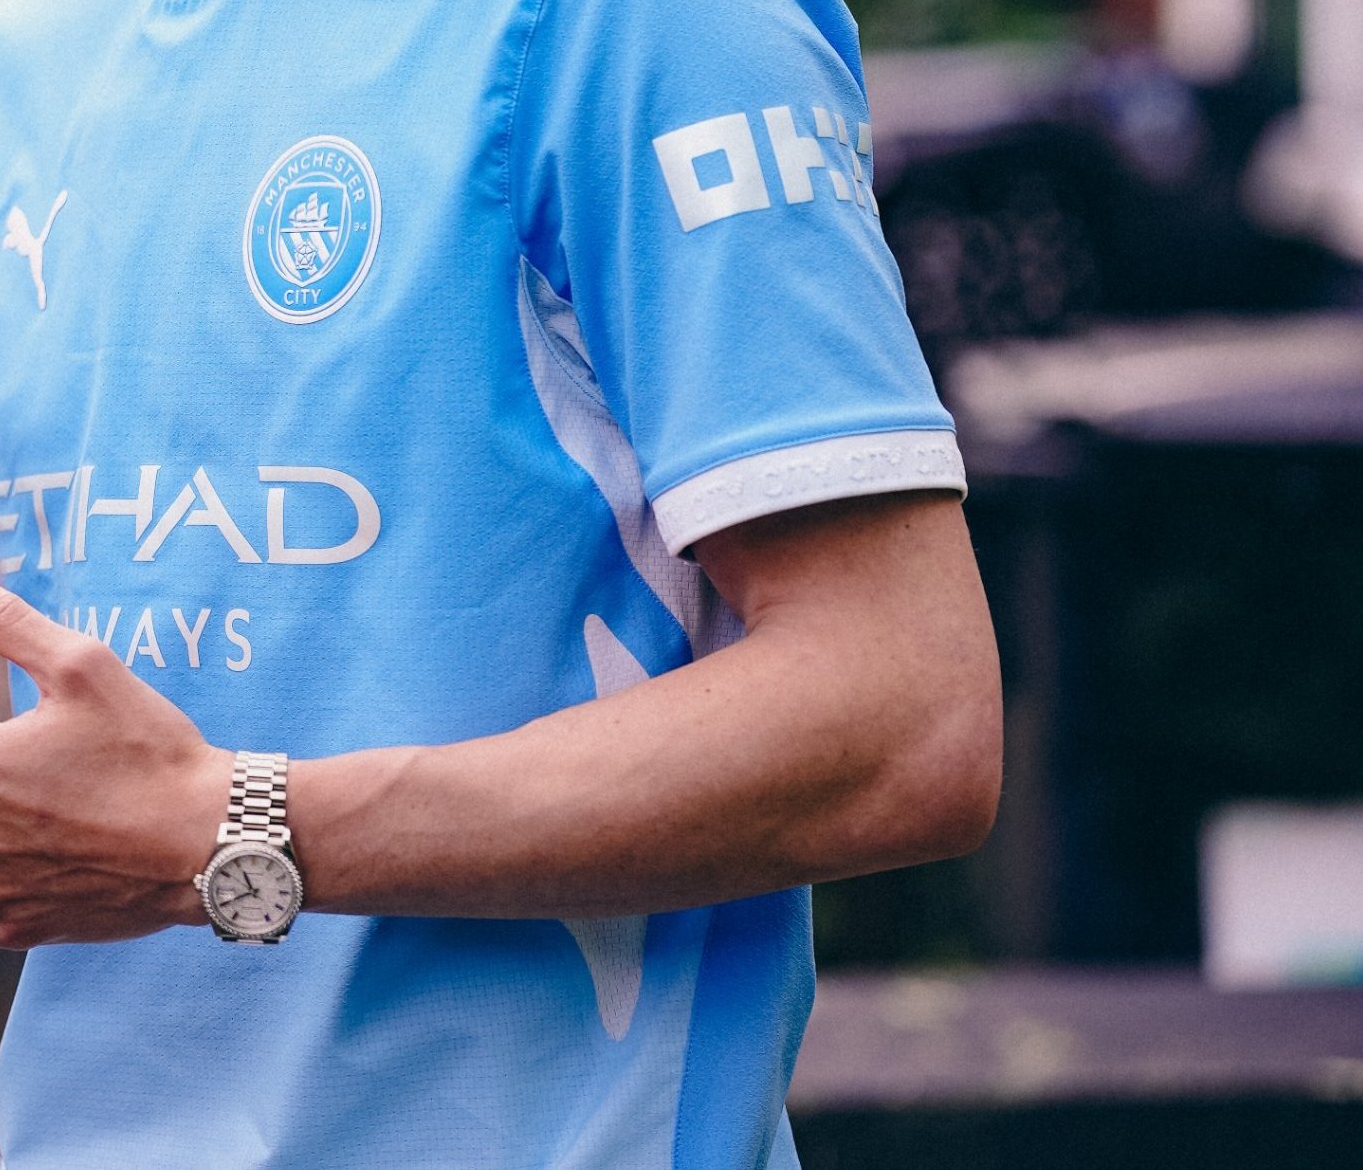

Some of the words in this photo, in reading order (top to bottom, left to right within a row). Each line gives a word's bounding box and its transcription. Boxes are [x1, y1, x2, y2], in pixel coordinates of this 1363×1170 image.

[265, 151, 366, 207] MANCHESTER
[353, 221, 368, 233] 94
[283, 289, 323, 306] CITY
